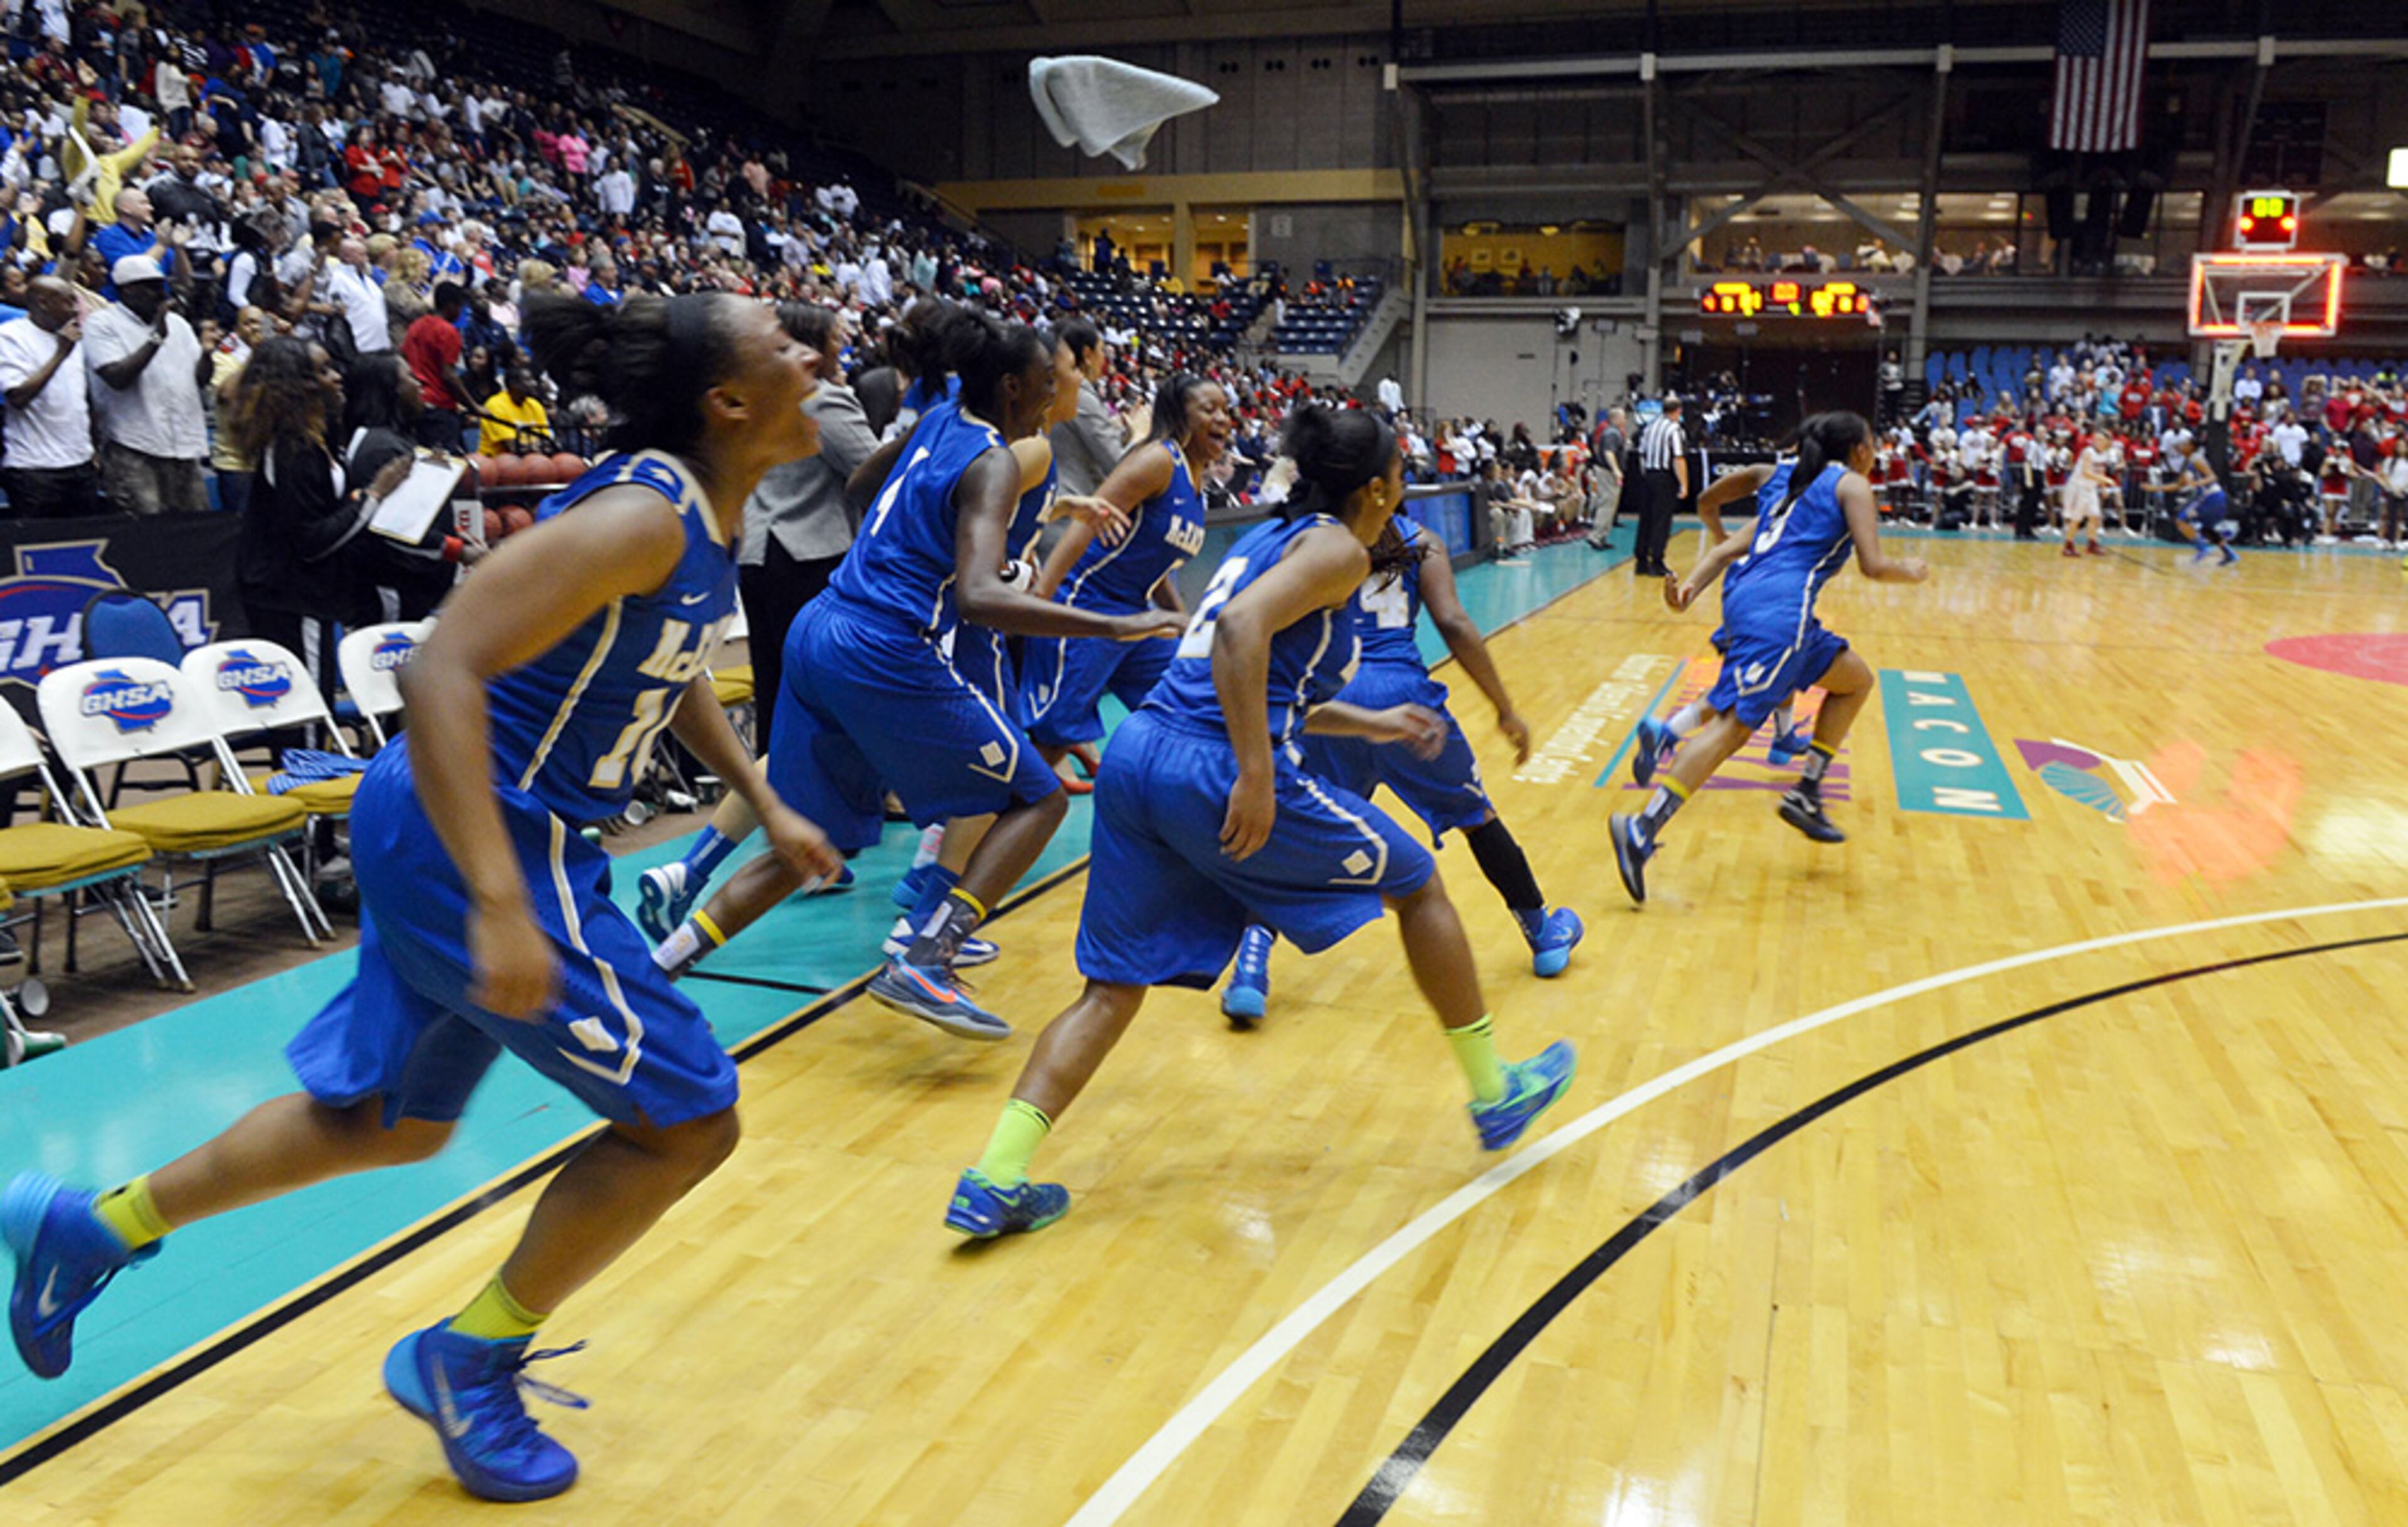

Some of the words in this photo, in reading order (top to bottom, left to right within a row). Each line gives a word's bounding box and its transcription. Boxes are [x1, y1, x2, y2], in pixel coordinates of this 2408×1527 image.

[218, 661, 292, 690] GHSA
[82, 680, 173, 716] GHSA
[1902, 670, 2002, 811] MACON
